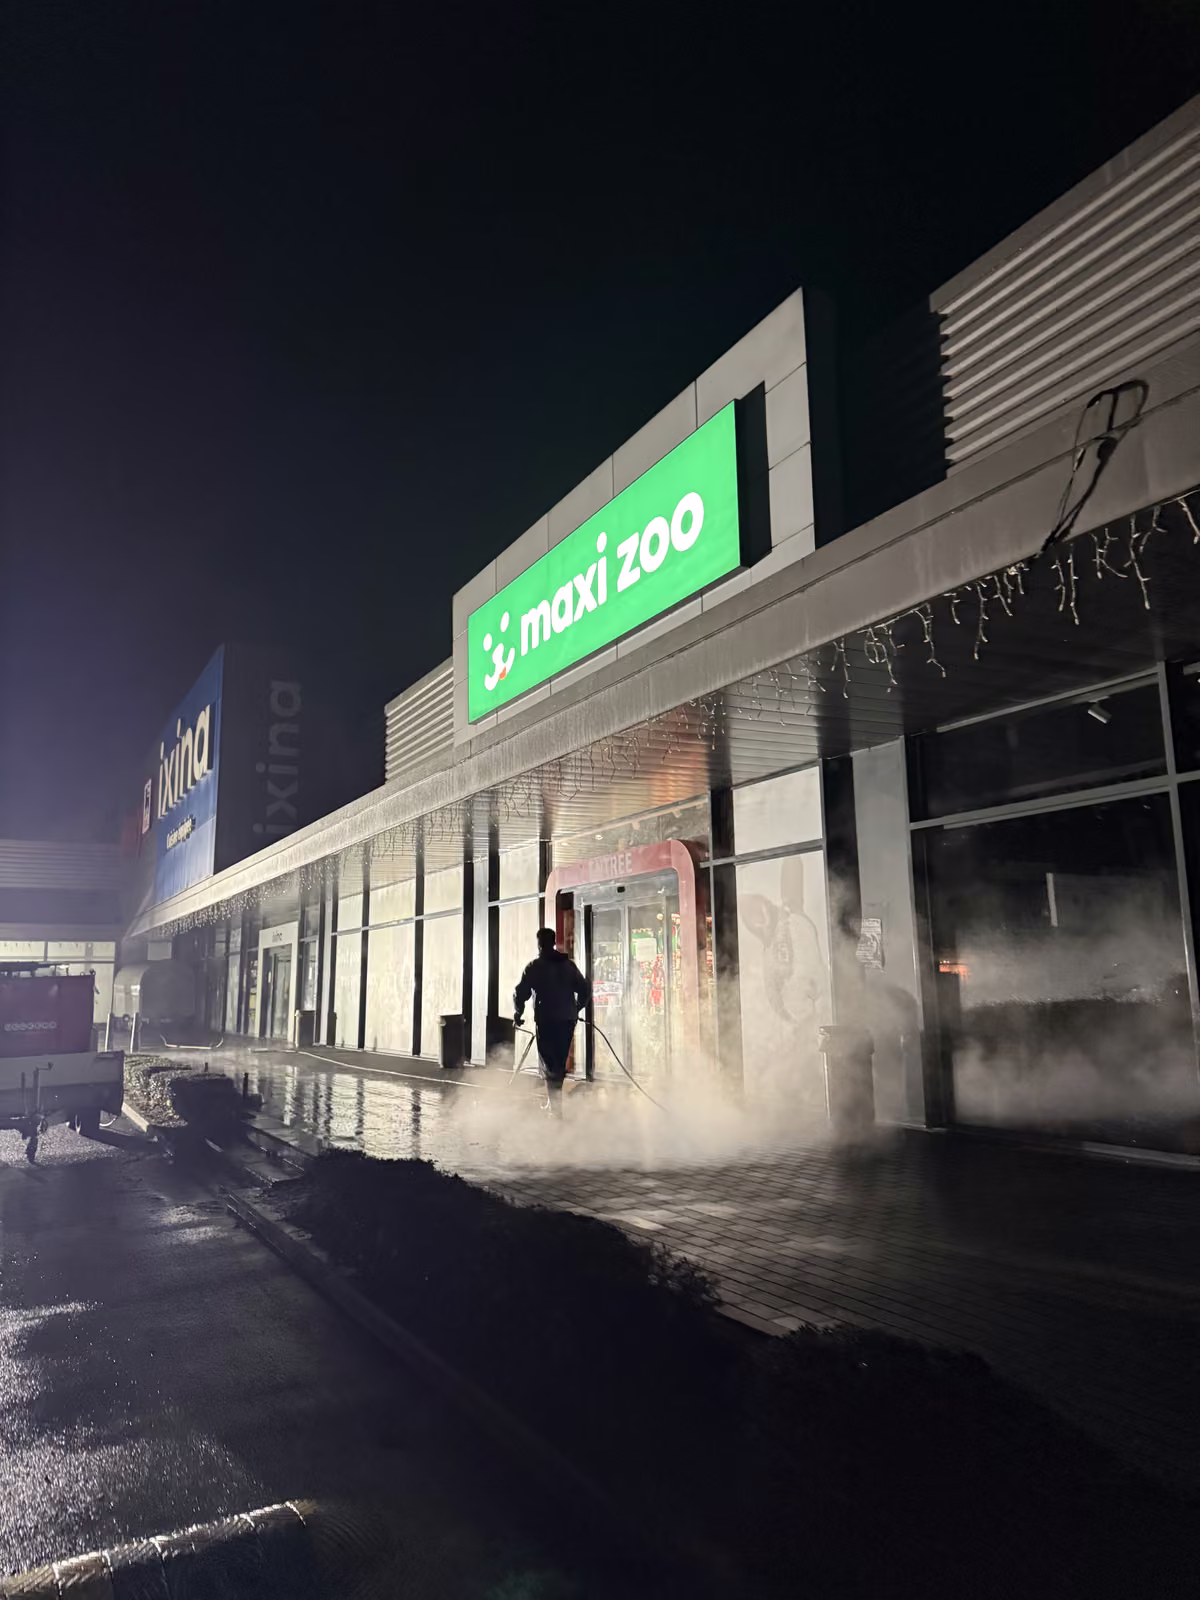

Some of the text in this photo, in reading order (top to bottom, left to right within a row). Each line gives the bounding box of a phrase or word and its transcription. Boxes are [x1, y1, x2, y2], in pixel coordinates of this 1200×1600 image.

[521, 492, 704, 656] maxi zoo
[158, 704, 210, 819] ixina
[253, 680, 301, 834] ixina
